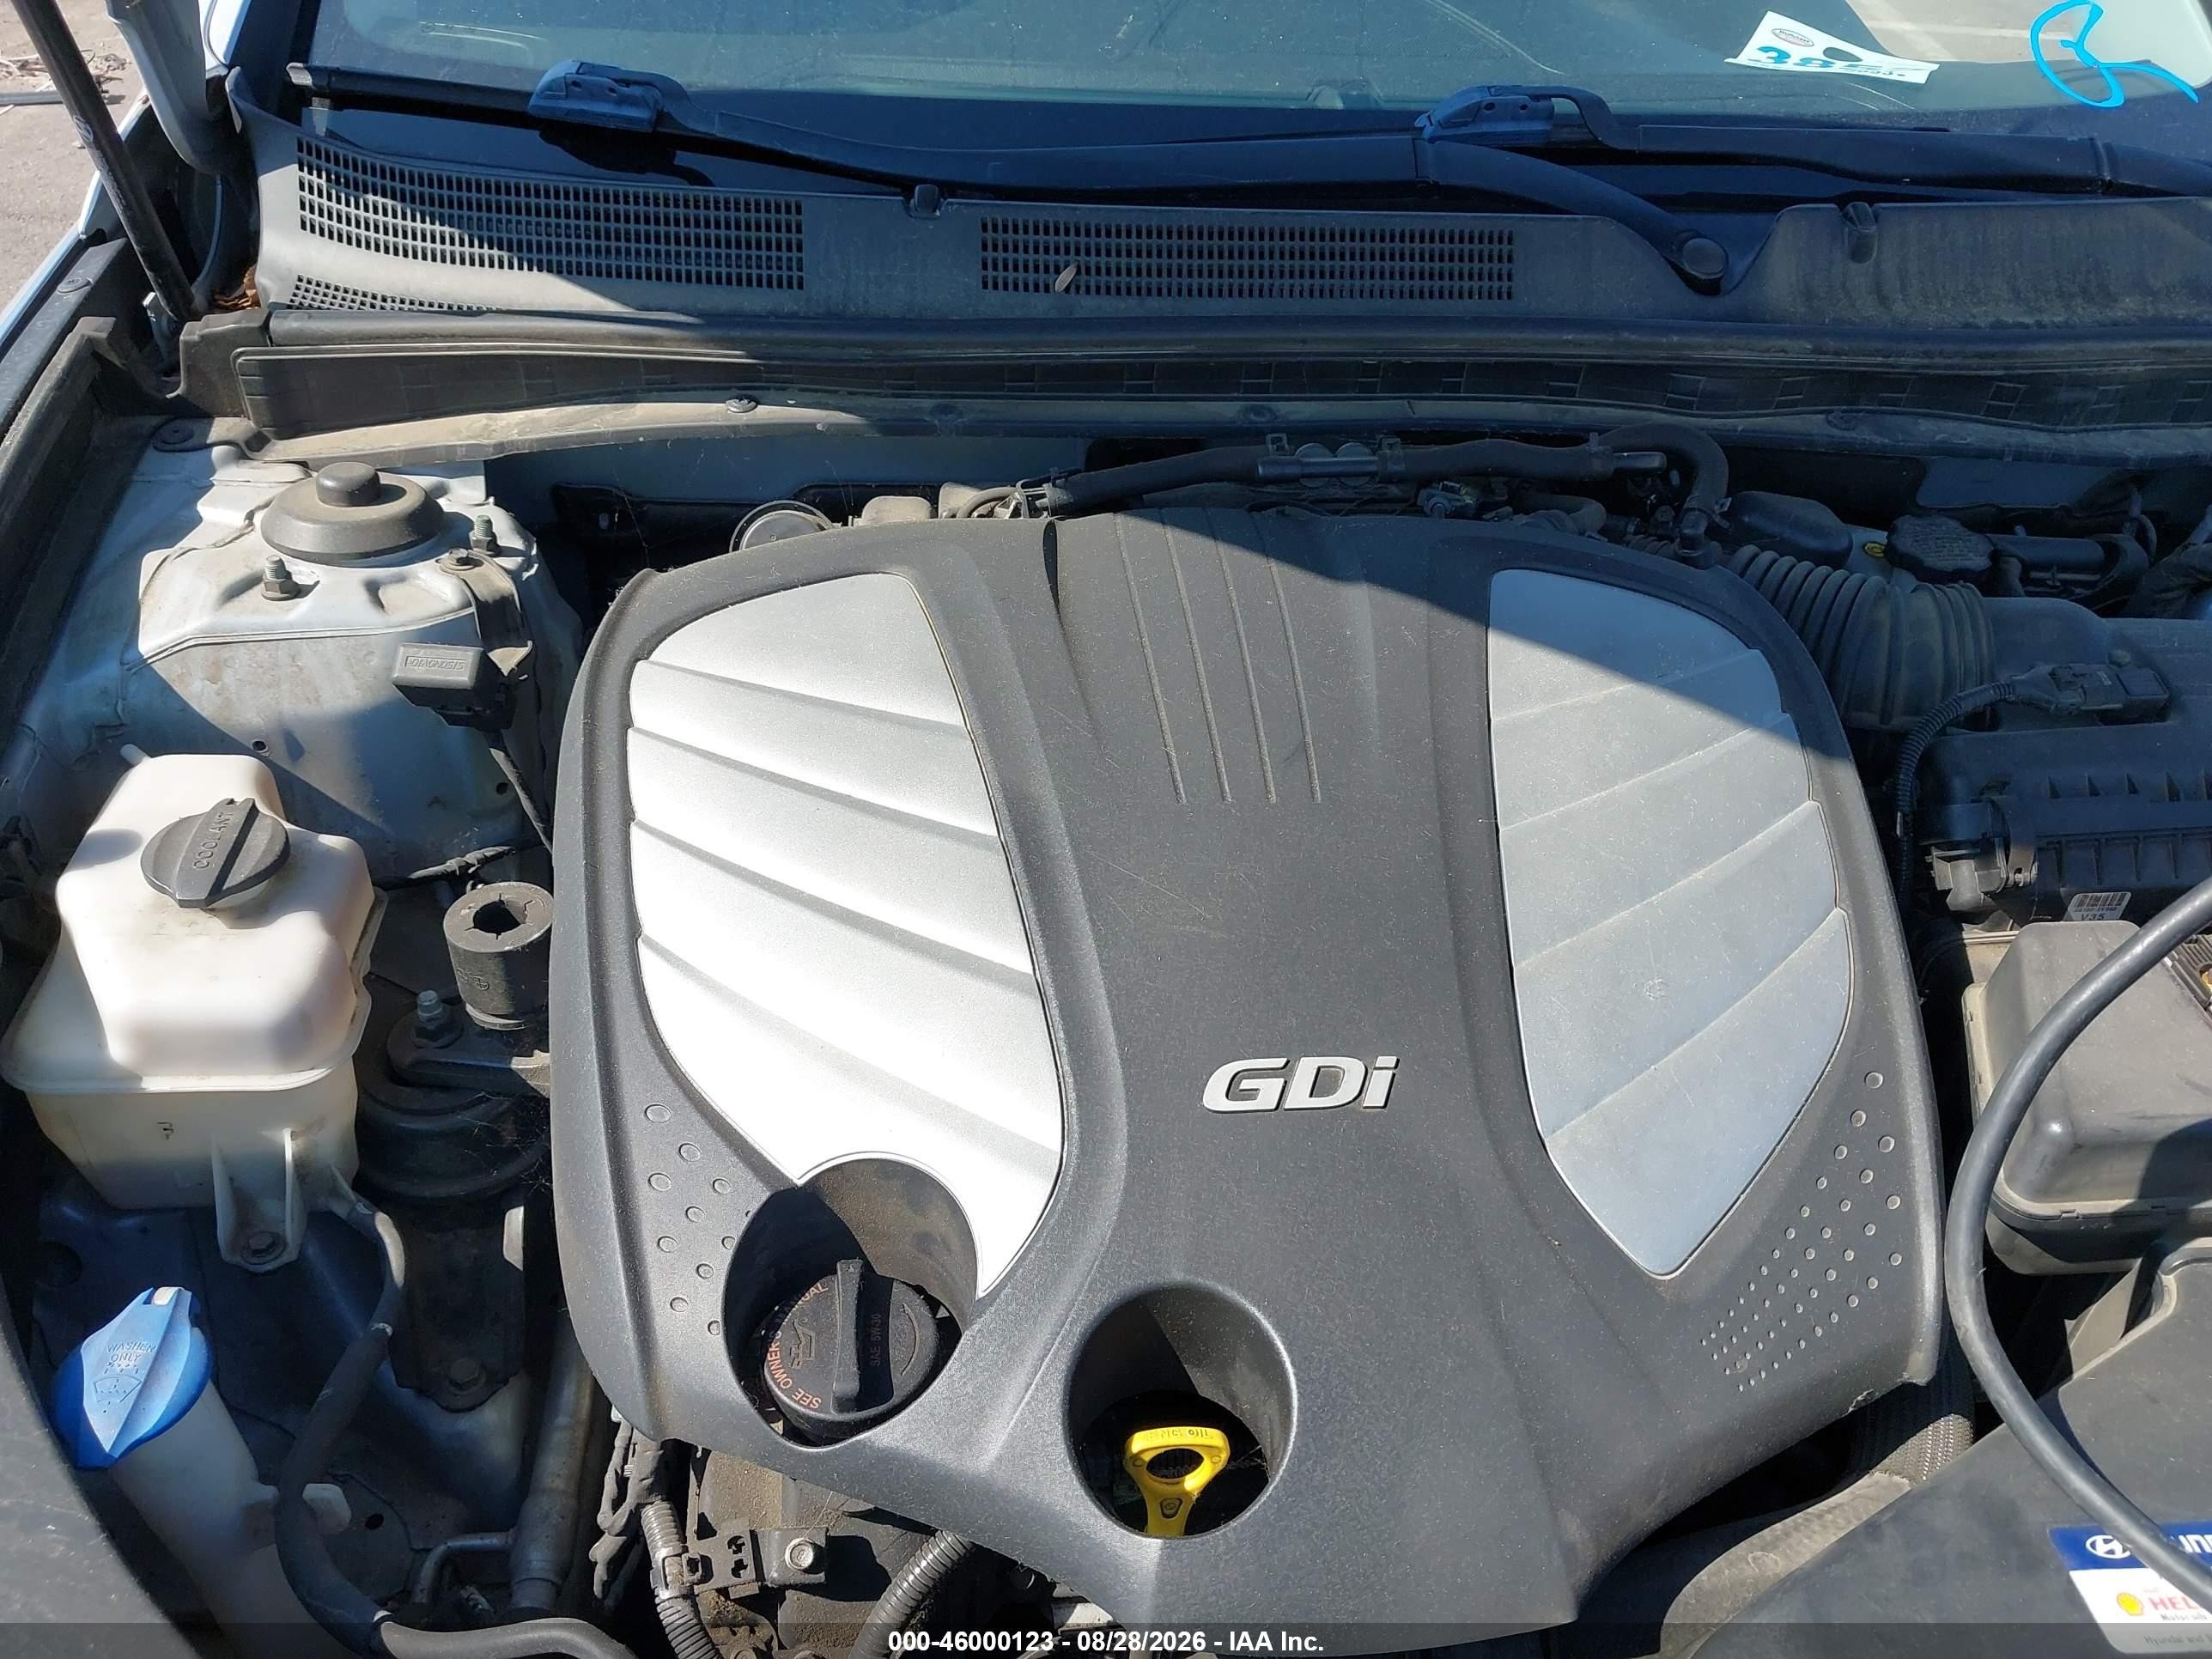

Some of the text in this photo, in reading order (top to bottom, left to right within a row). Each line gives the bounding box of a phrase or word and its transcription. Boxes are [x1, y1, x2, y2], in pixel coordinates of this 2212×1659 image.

[193, 811, 234, 869] COOLANT
[1202, 1056, 1401, 1114] GDi
[106, 1341, 156, 1353] WASHER
[110, 1352, 142, 1362] ONLY
[792, 1388, 822, 1409] SEE
